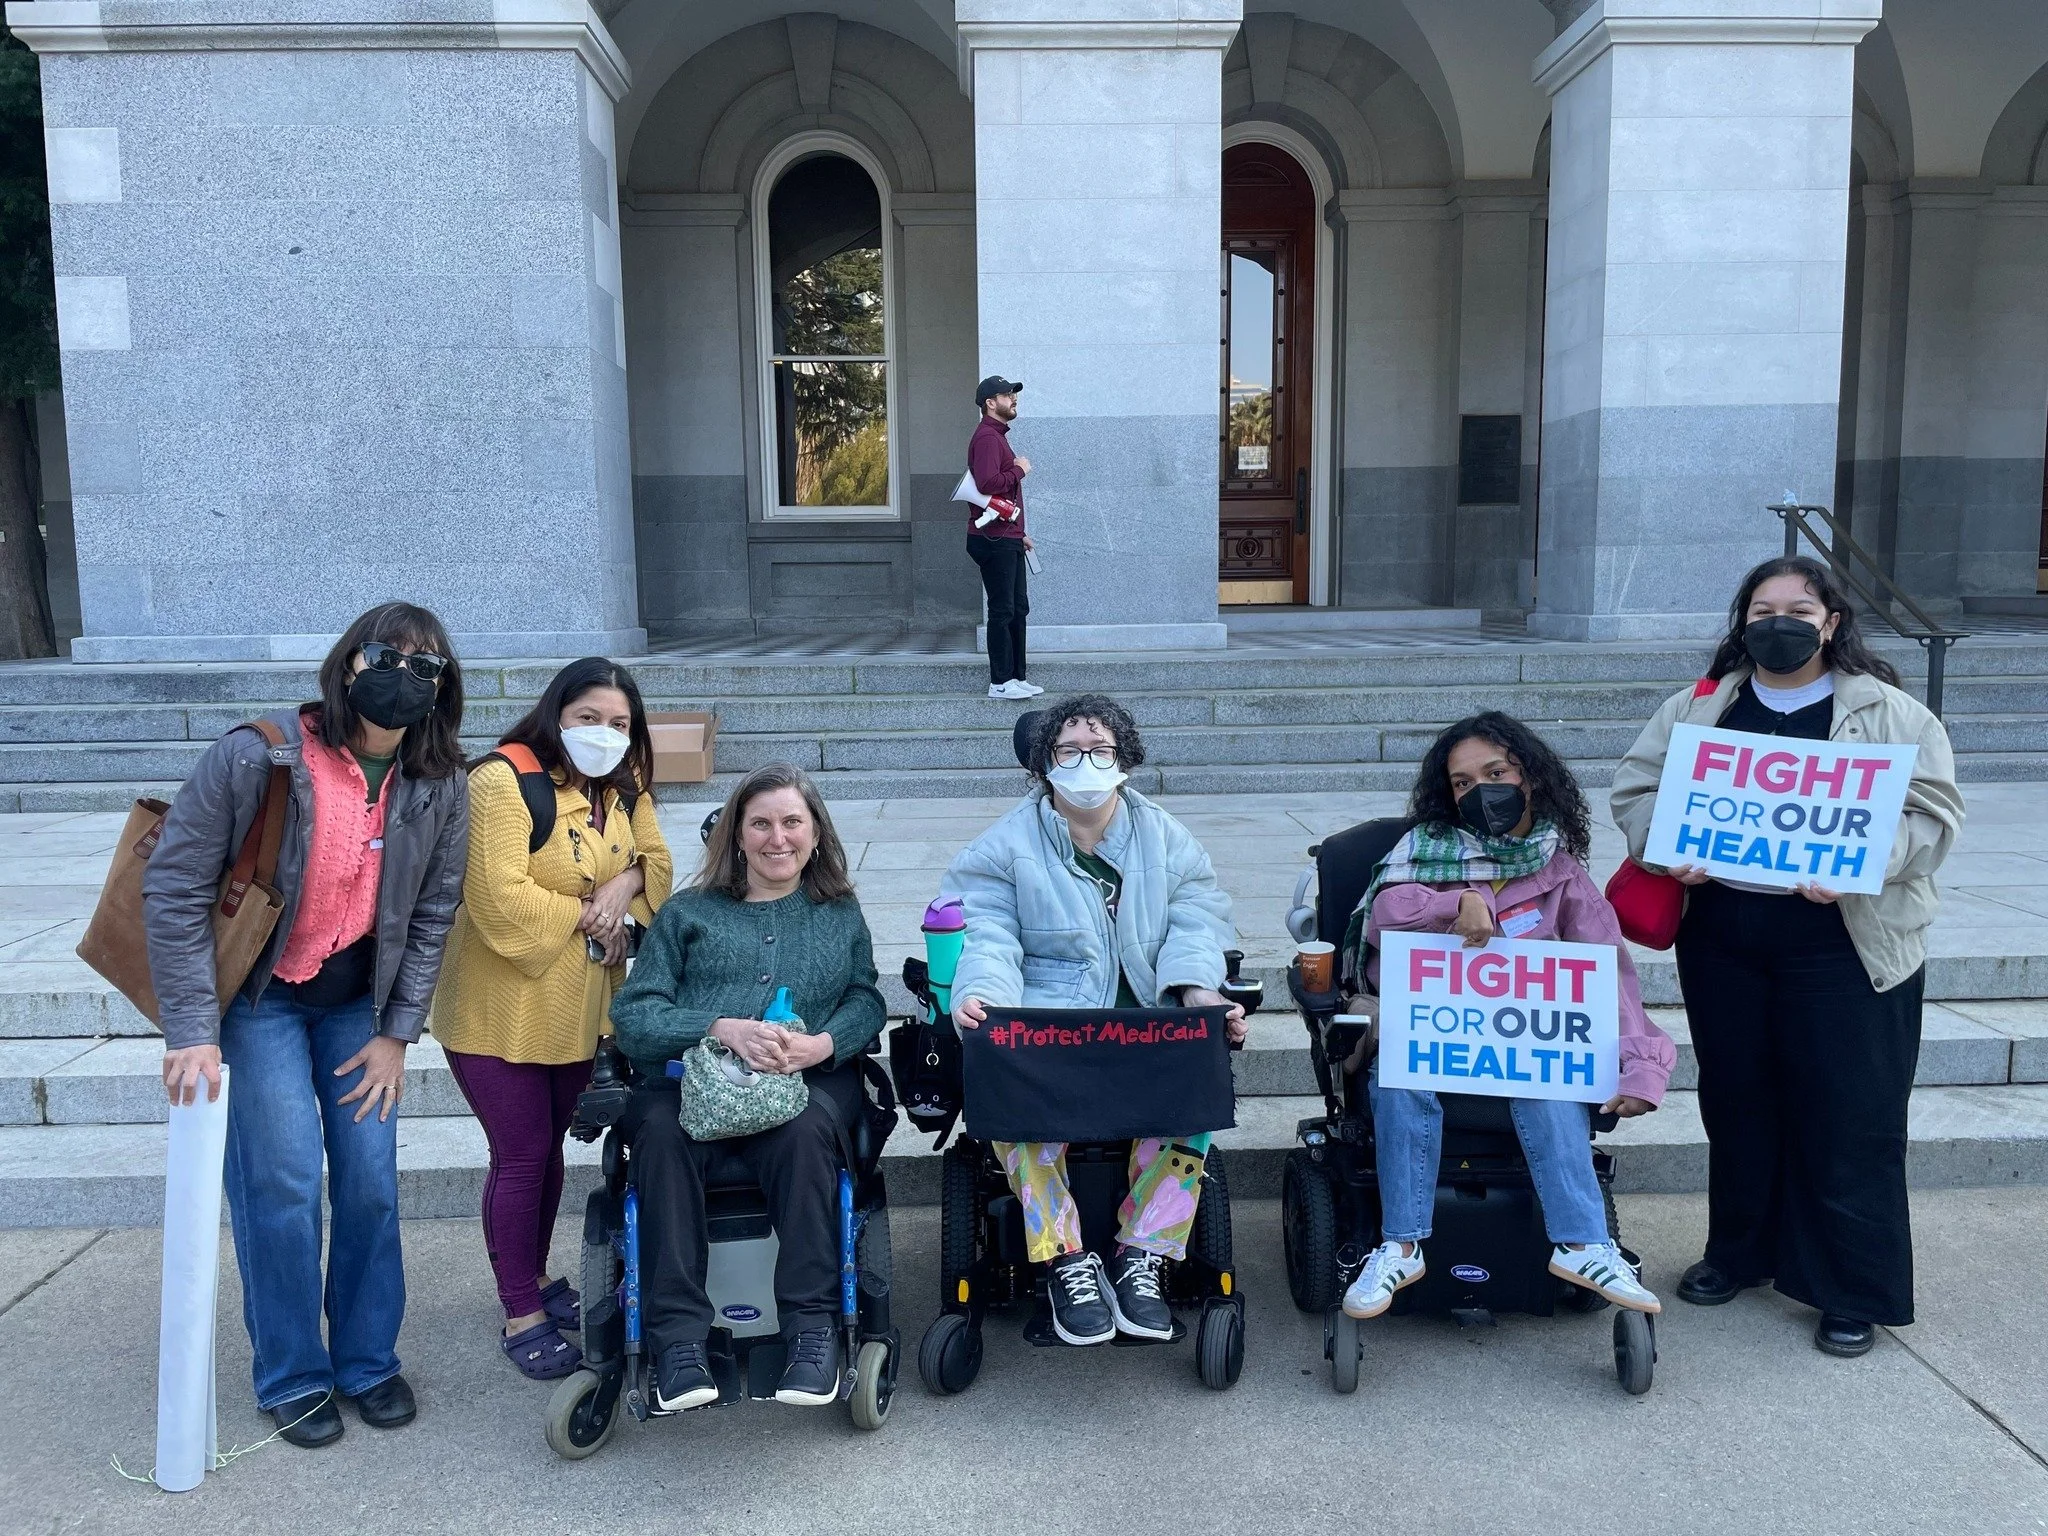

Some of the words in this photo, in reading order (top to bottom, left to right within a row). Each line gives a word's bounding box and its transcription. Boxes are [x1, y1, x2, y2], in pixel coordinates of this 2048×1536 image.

[1692, 741, 1892, 800] FIGHT
[1685, 792, 1765, 828] FOR
[1772, 802, 1872, 838] OUR
[1675, 824, 1867, 878] HEALTH
[1409, 948, 1597, 1003] FIGHT
[1410, 1004, 1485, 1036] FOR
[1492, 1006, 1592, 1043] OUR
[1408, 1040, 1595, 1086] HEALTH
